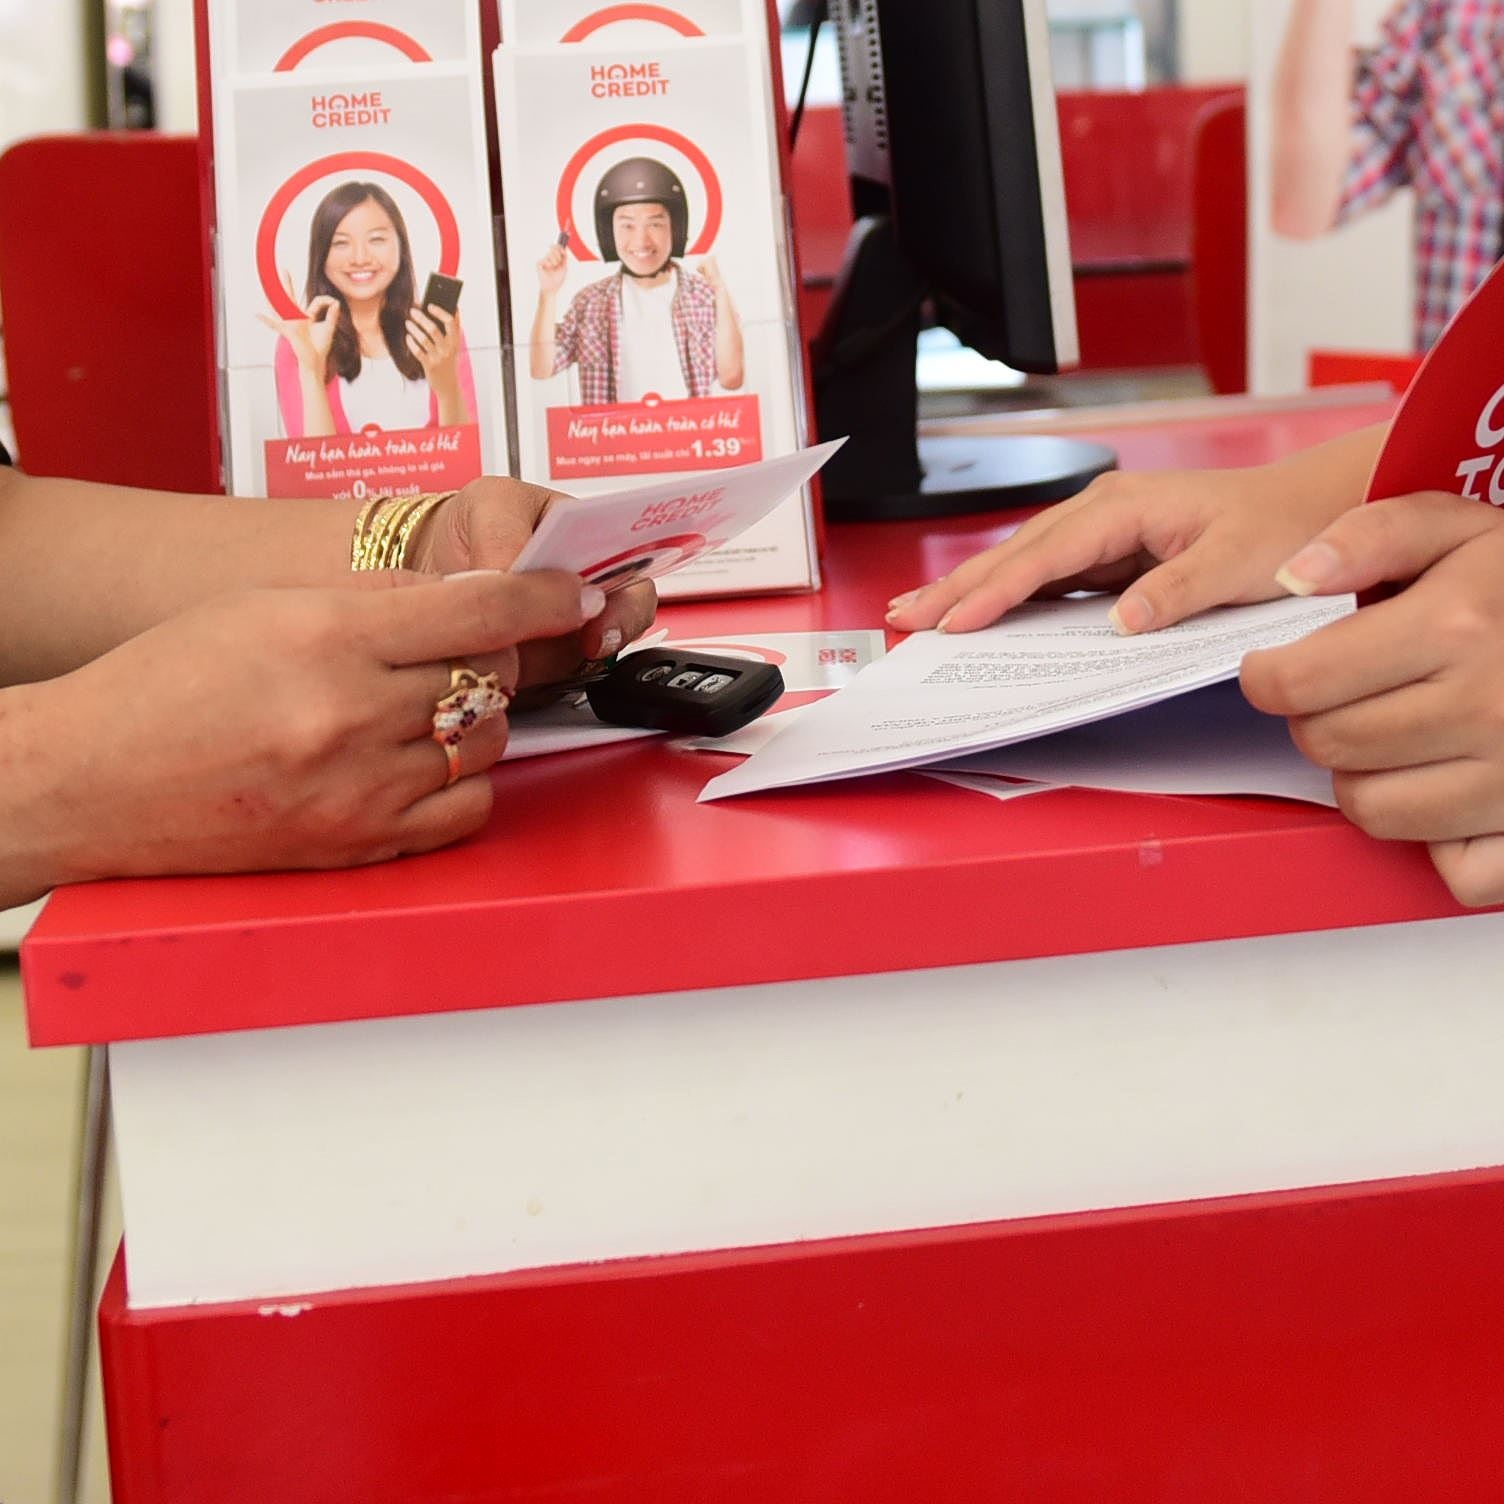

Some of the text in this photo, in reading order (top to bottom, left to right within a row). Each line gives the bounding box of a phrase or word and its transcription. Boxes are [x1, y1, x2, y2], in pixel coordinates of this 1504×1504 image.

[590, 62, 661, 81] HOME
[591, 79, 670, 99] CREDIT
[311, 92, 383, 112] HOME
[312, 108, 392, 129] CREDIT
